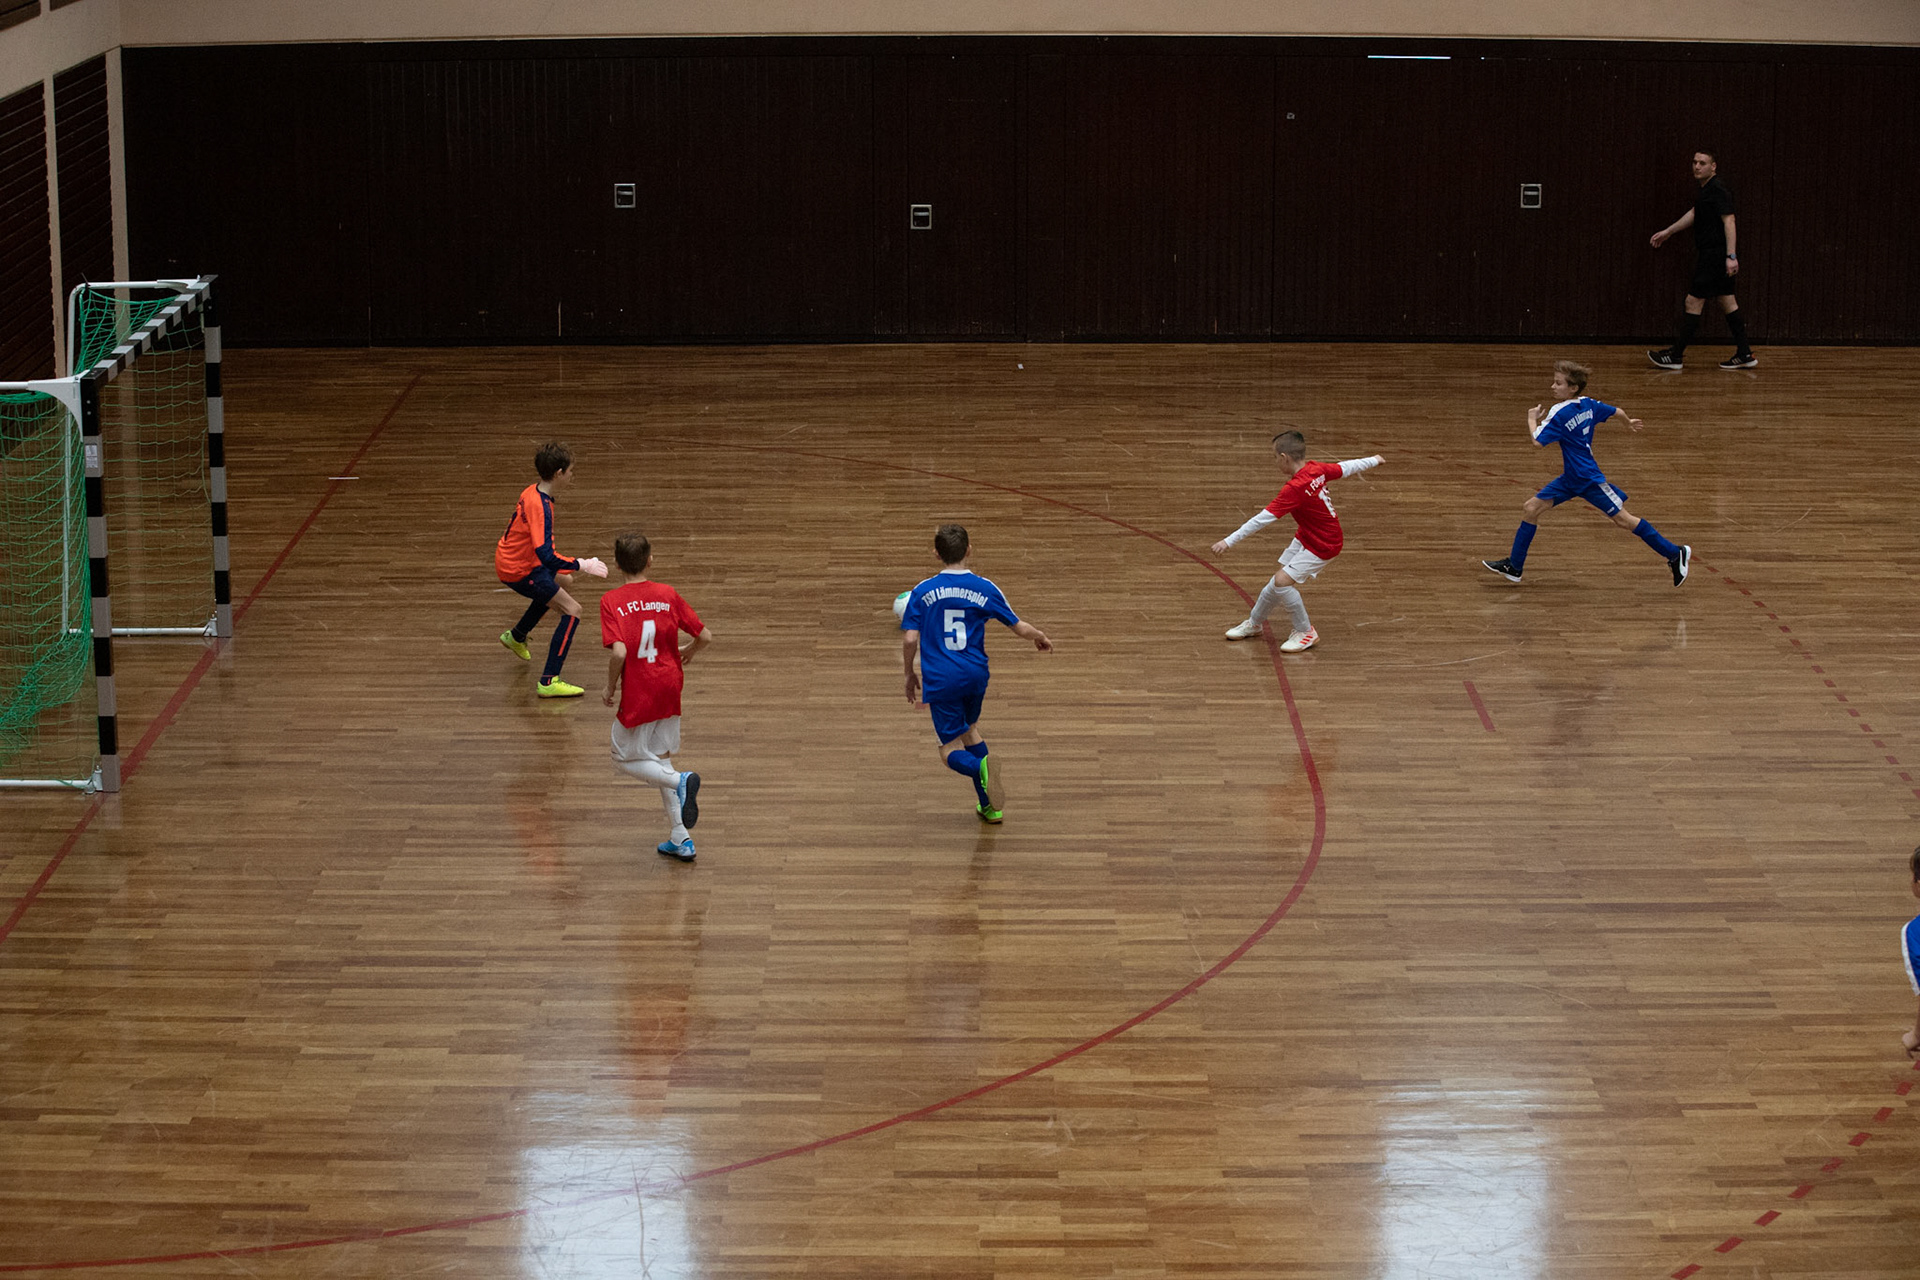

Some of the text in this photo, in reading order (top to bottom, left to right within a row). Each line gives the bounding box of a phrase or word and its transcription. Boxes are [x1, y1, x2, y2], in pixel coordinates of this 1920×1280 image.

[617, 600, 671, 617] 1. FC Langen
[921, 586, 989, 607] TSV Lämmerspiel
[637, 619, 658, 663] 4
[944, 609, 967, 651] 5
